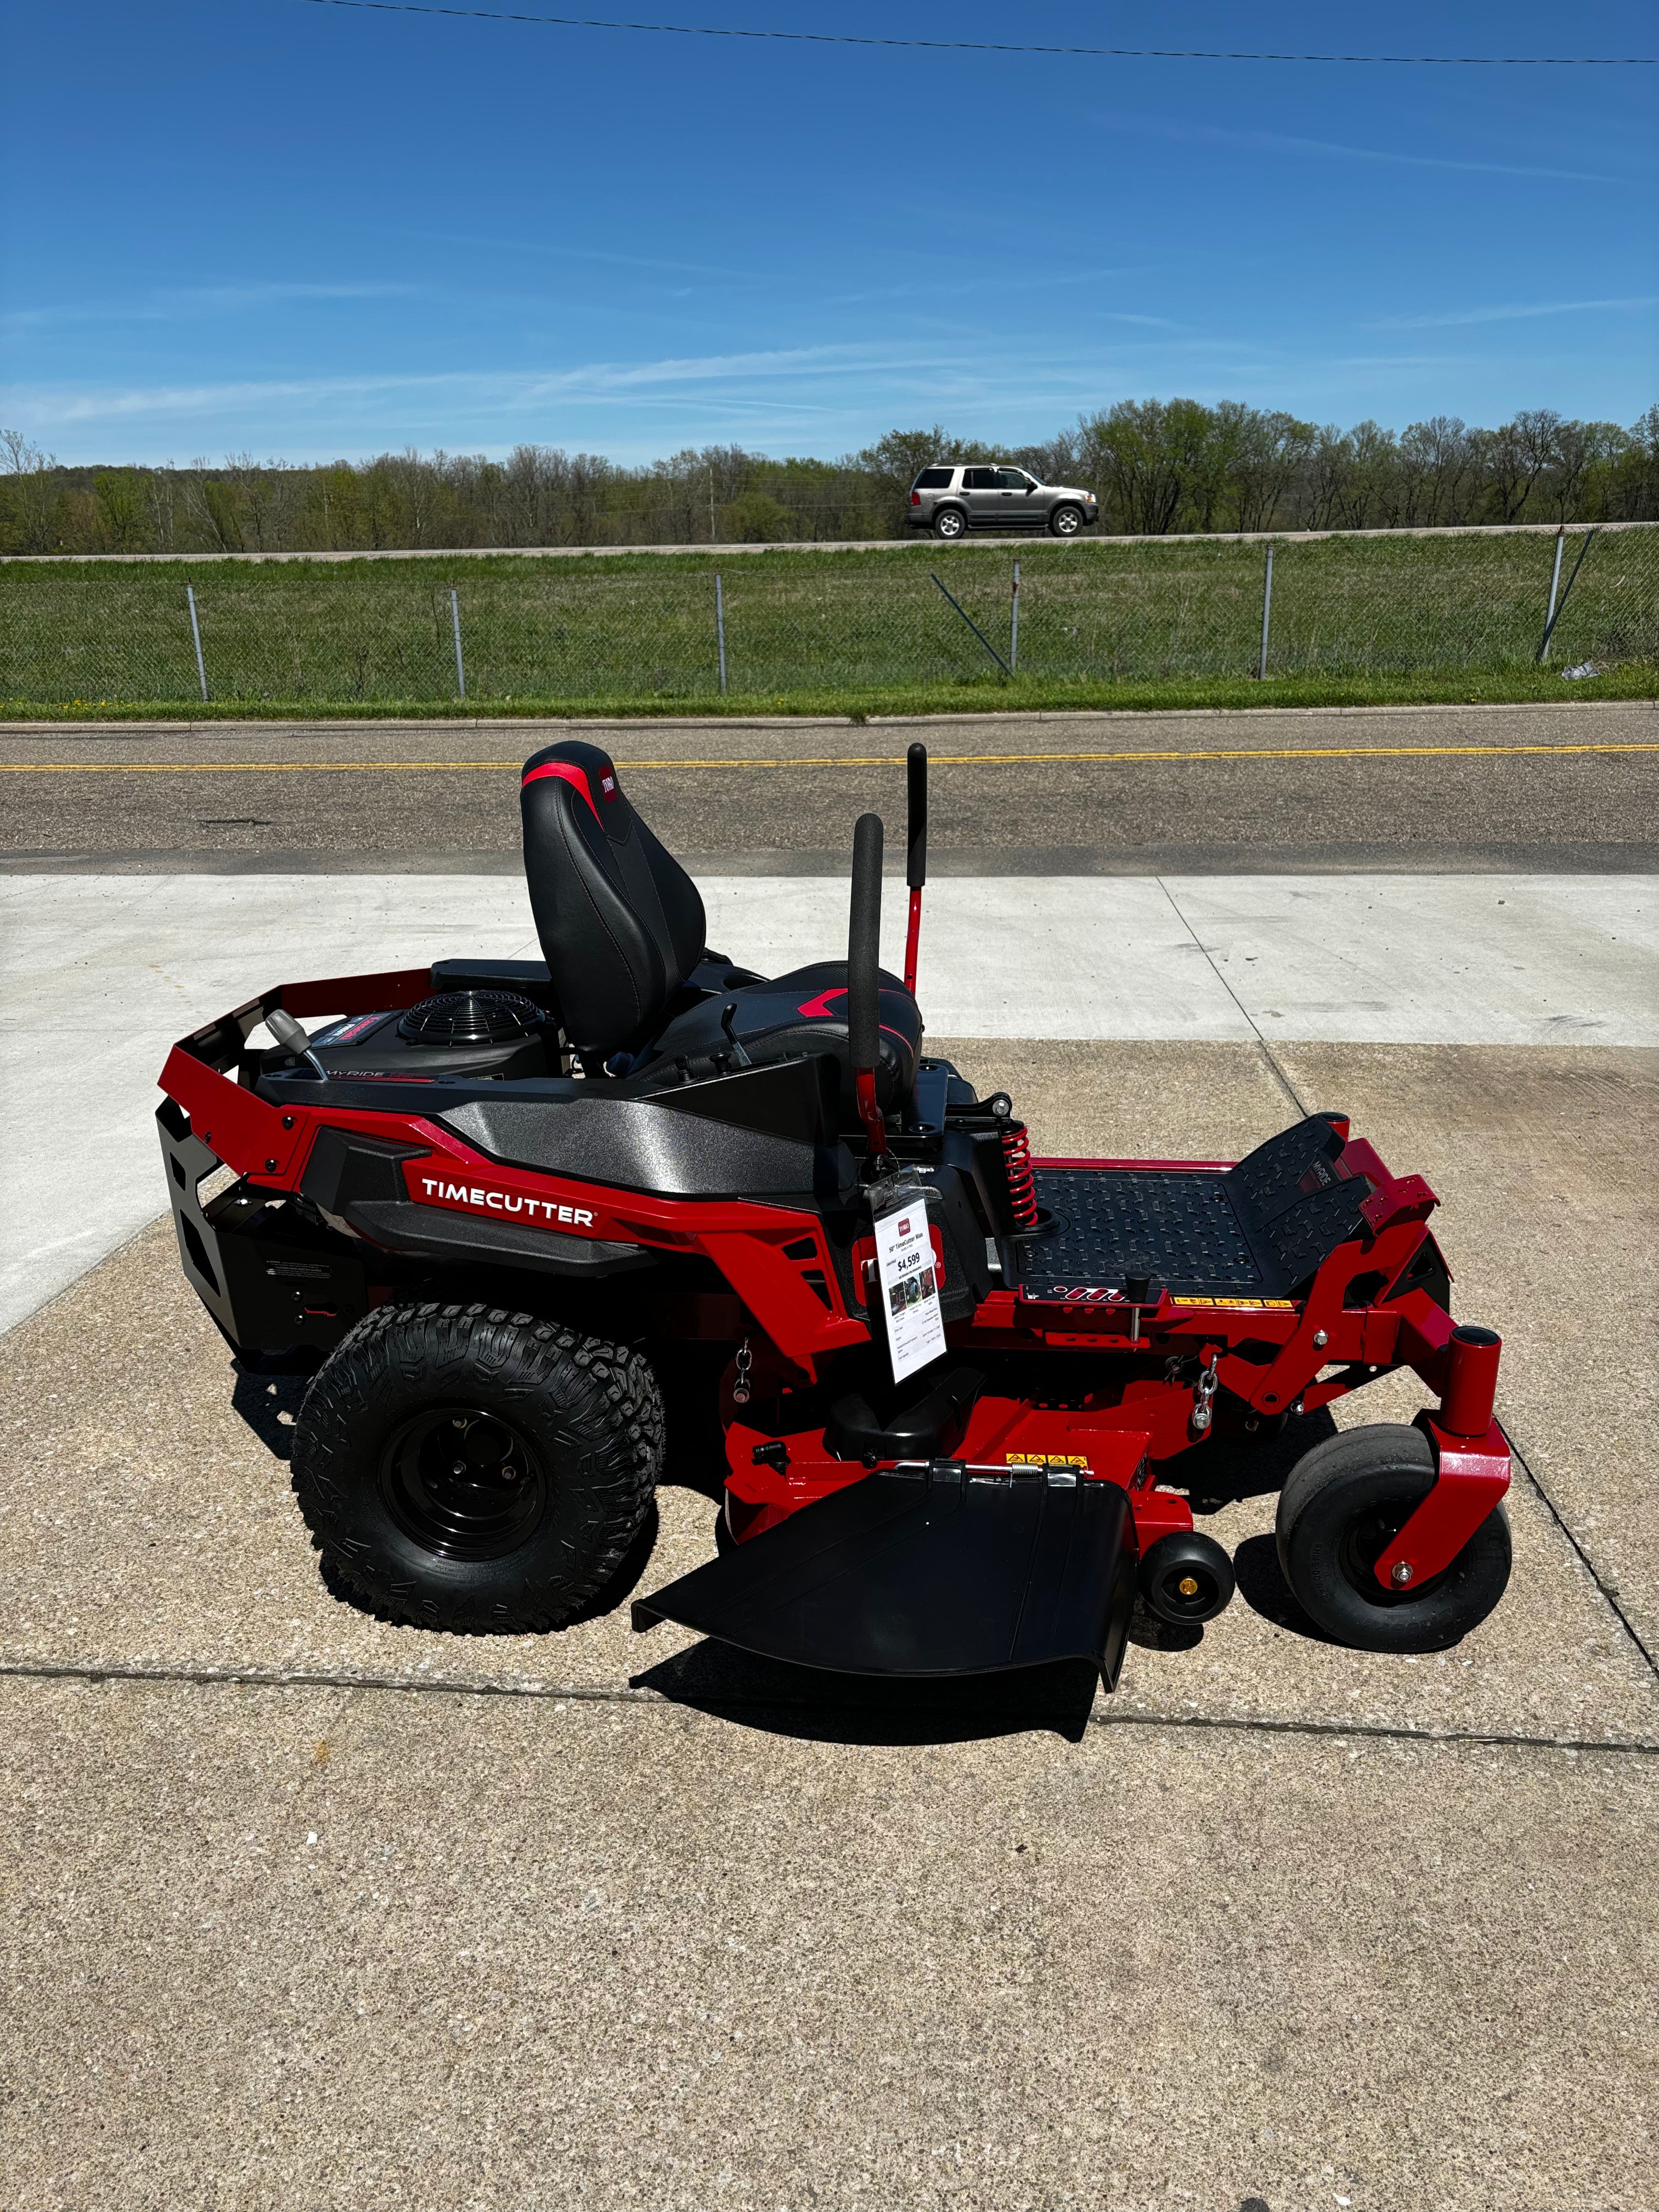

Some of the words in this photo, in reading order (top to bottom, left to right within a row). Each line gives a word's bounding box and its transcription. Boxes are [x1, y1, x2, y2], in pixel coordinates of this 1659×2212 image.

[422, 1178, 594, 1228] TIMECUTTER
[895, 1237, 915, 1249] TimeCutter
[898, 1252, 920, 1272] $4,599
